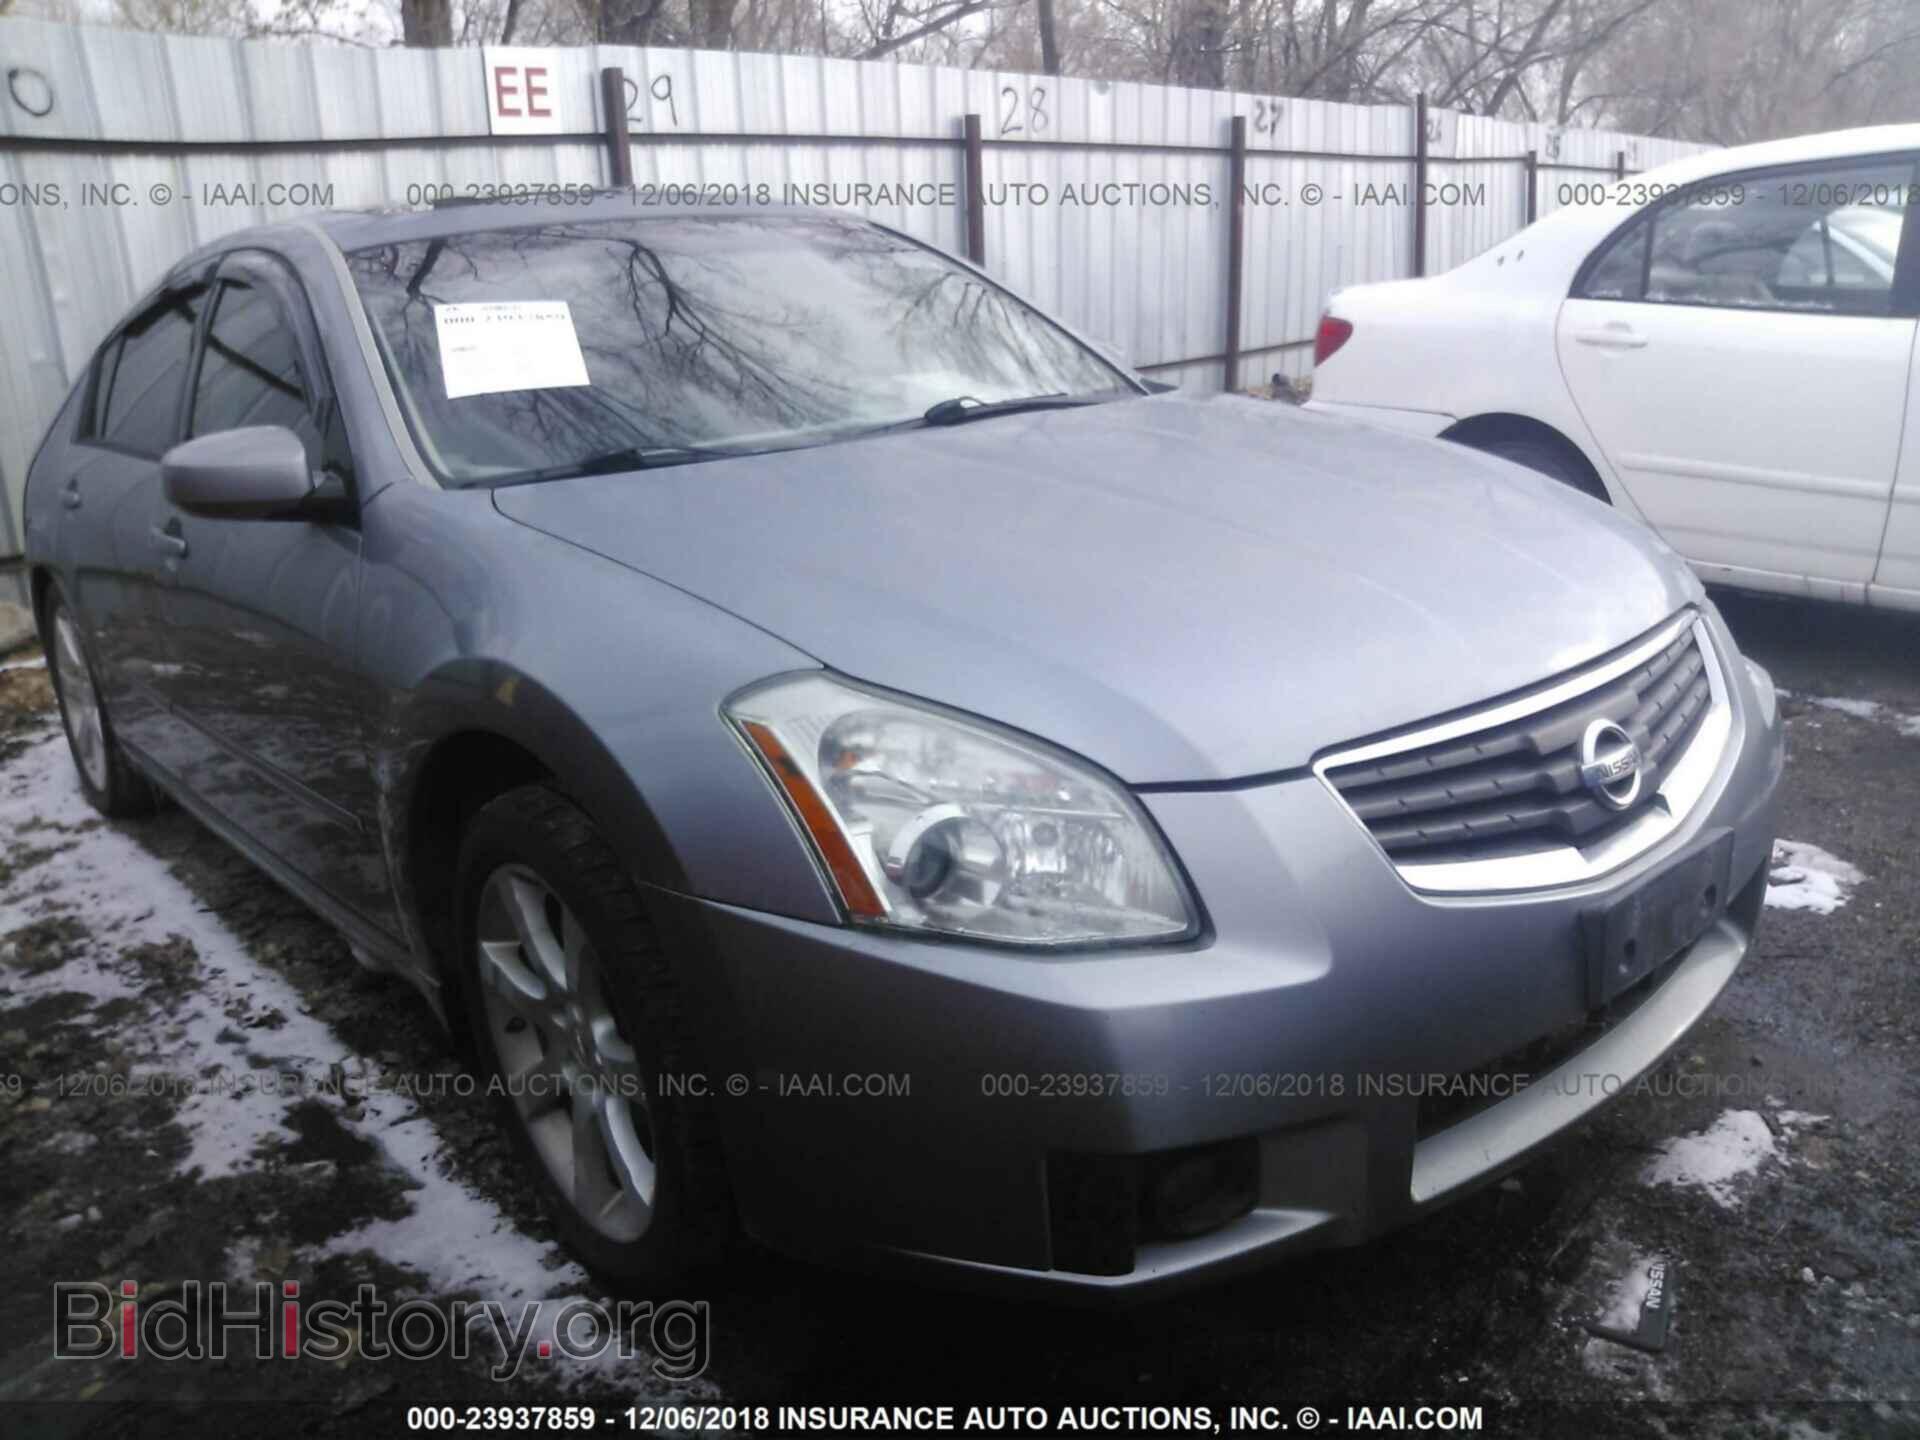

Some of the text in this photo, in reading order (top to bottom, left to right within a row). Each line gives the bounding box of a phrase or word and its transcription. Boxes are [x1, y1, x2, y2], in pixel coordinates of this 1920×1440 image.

[494, 66, 552, 118] EE
[622, 74, 678, 127] 29
[1001, 86, 1049, 135] 28
[1254, 100, 1284, 137] 27
